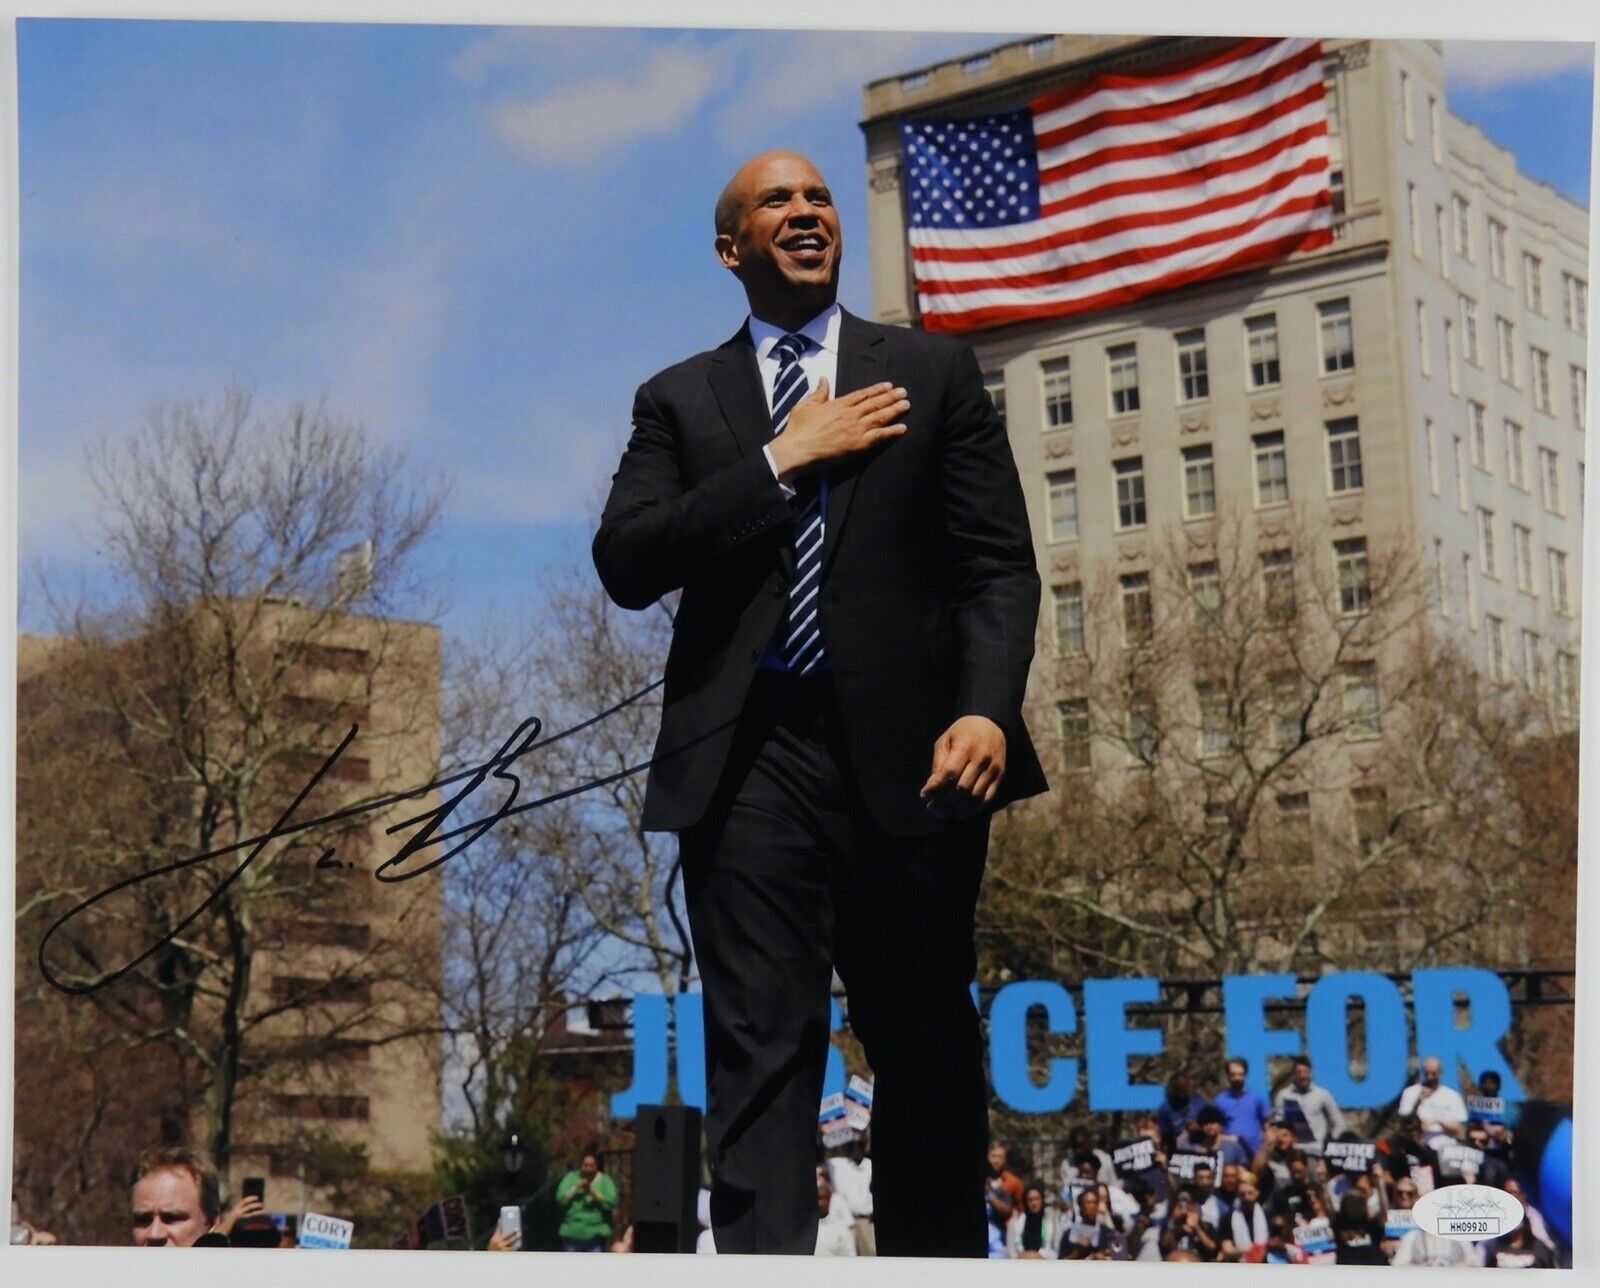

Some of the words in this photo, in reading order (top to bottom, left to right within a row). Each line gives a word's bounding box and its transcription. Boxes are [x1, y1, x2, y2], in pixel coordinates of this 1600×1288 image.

[1223, 966, 1527, 1111] FOR
[306, 1216, 348, 1238] CORY
[1449, 1221, 1488, 1232] HH09920
